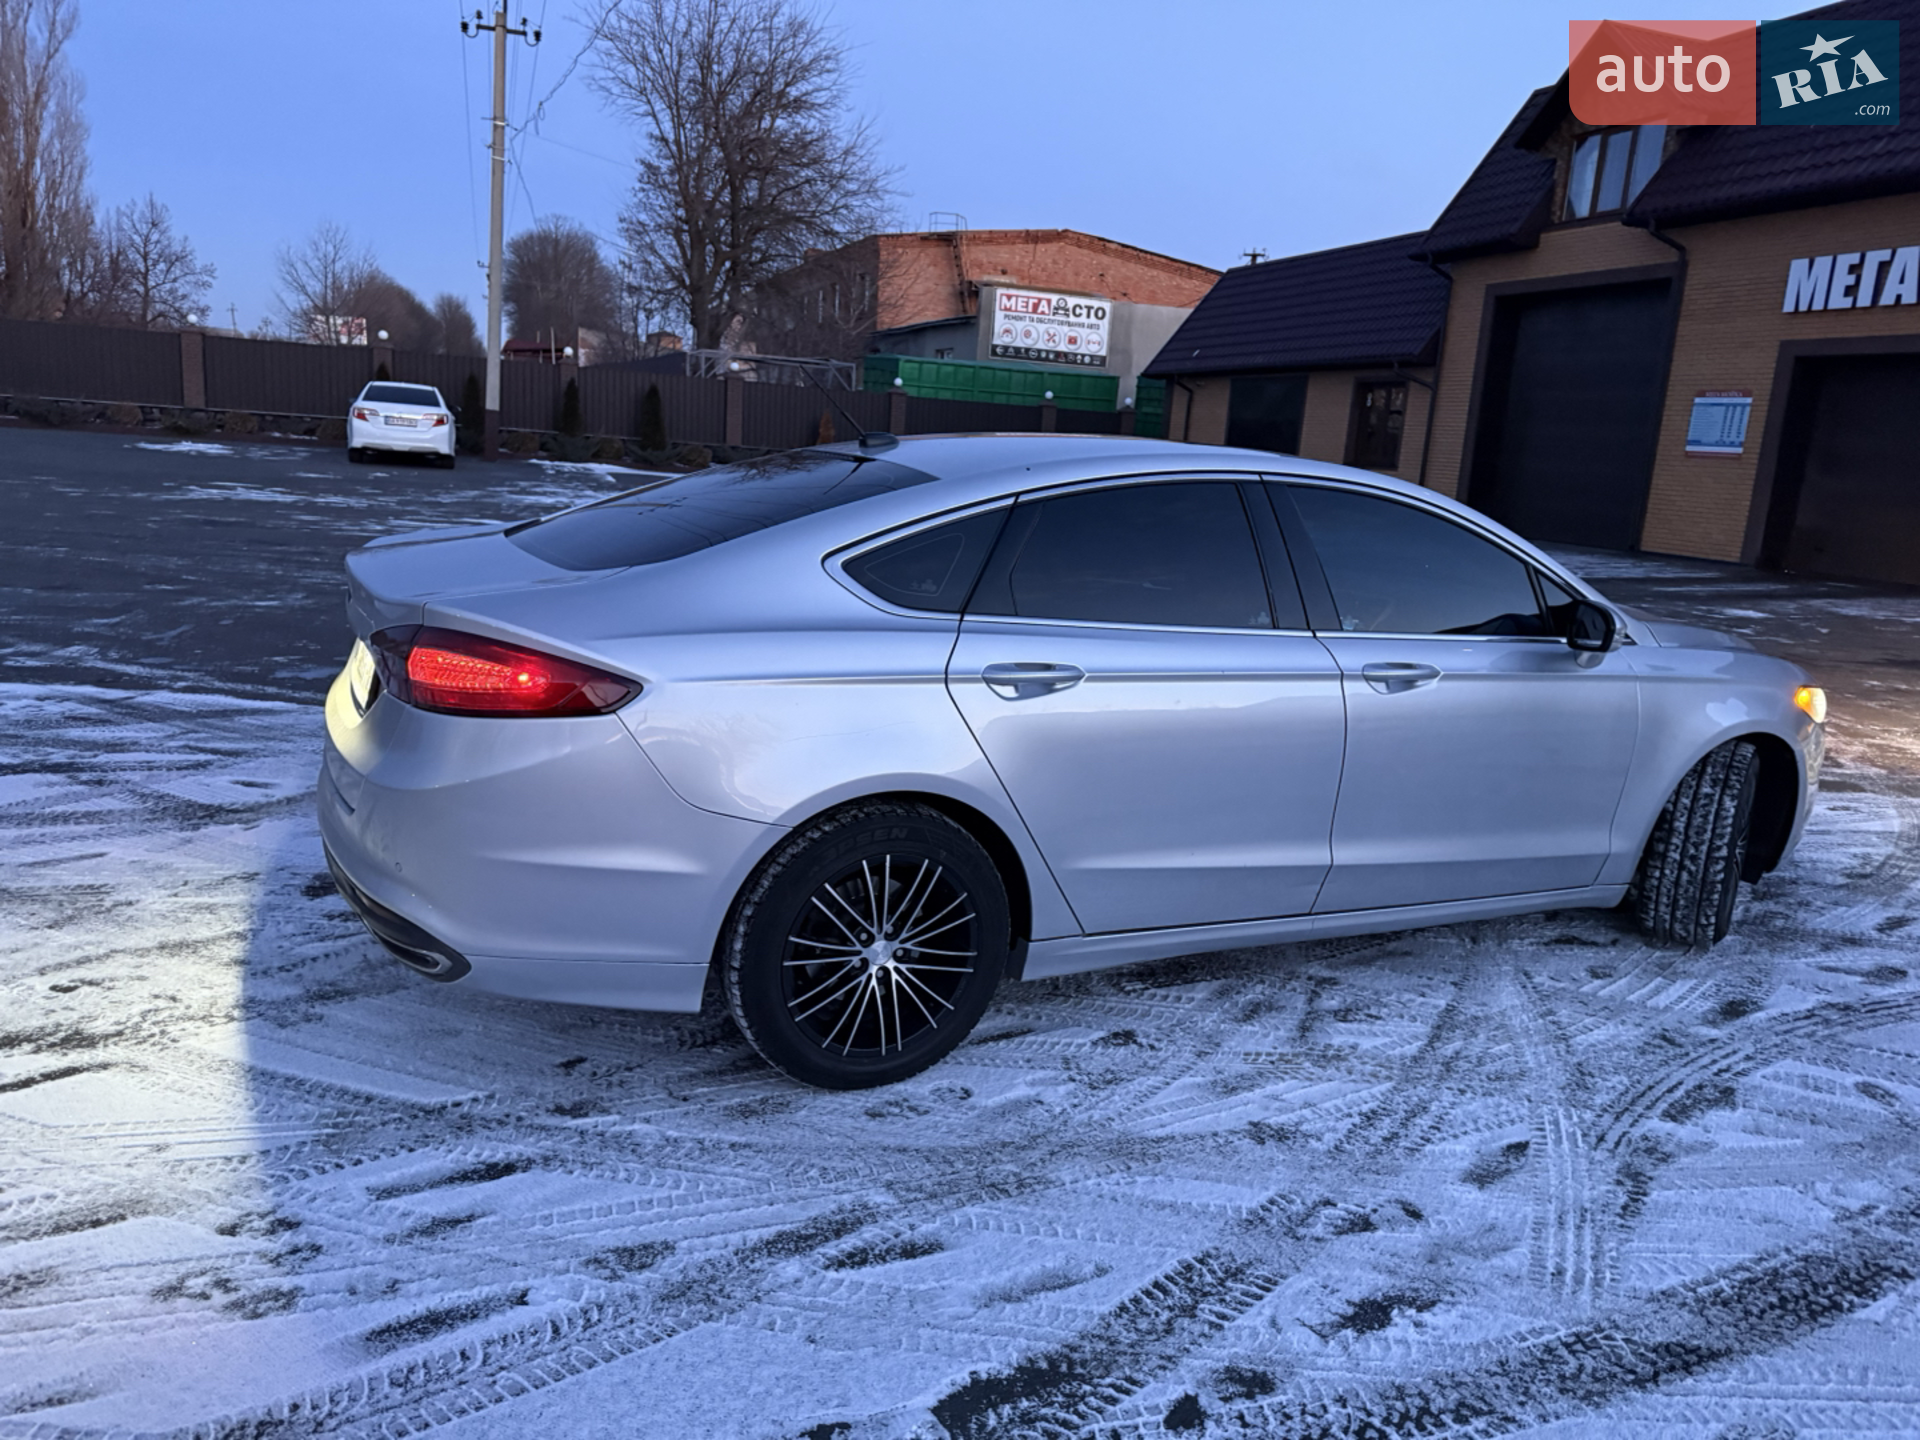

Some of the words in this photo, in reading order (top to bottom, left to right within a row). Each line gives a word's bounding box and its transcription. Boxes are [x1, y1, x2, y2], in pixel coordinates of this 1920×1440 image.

[1782, 245, 1920, 313] МЕГА
[1000, 294, 1051, 315] МЕГА
[1071, 304, 1107, 321] СТО
[1003, 313, 1027, 322] РЕМОНТ
